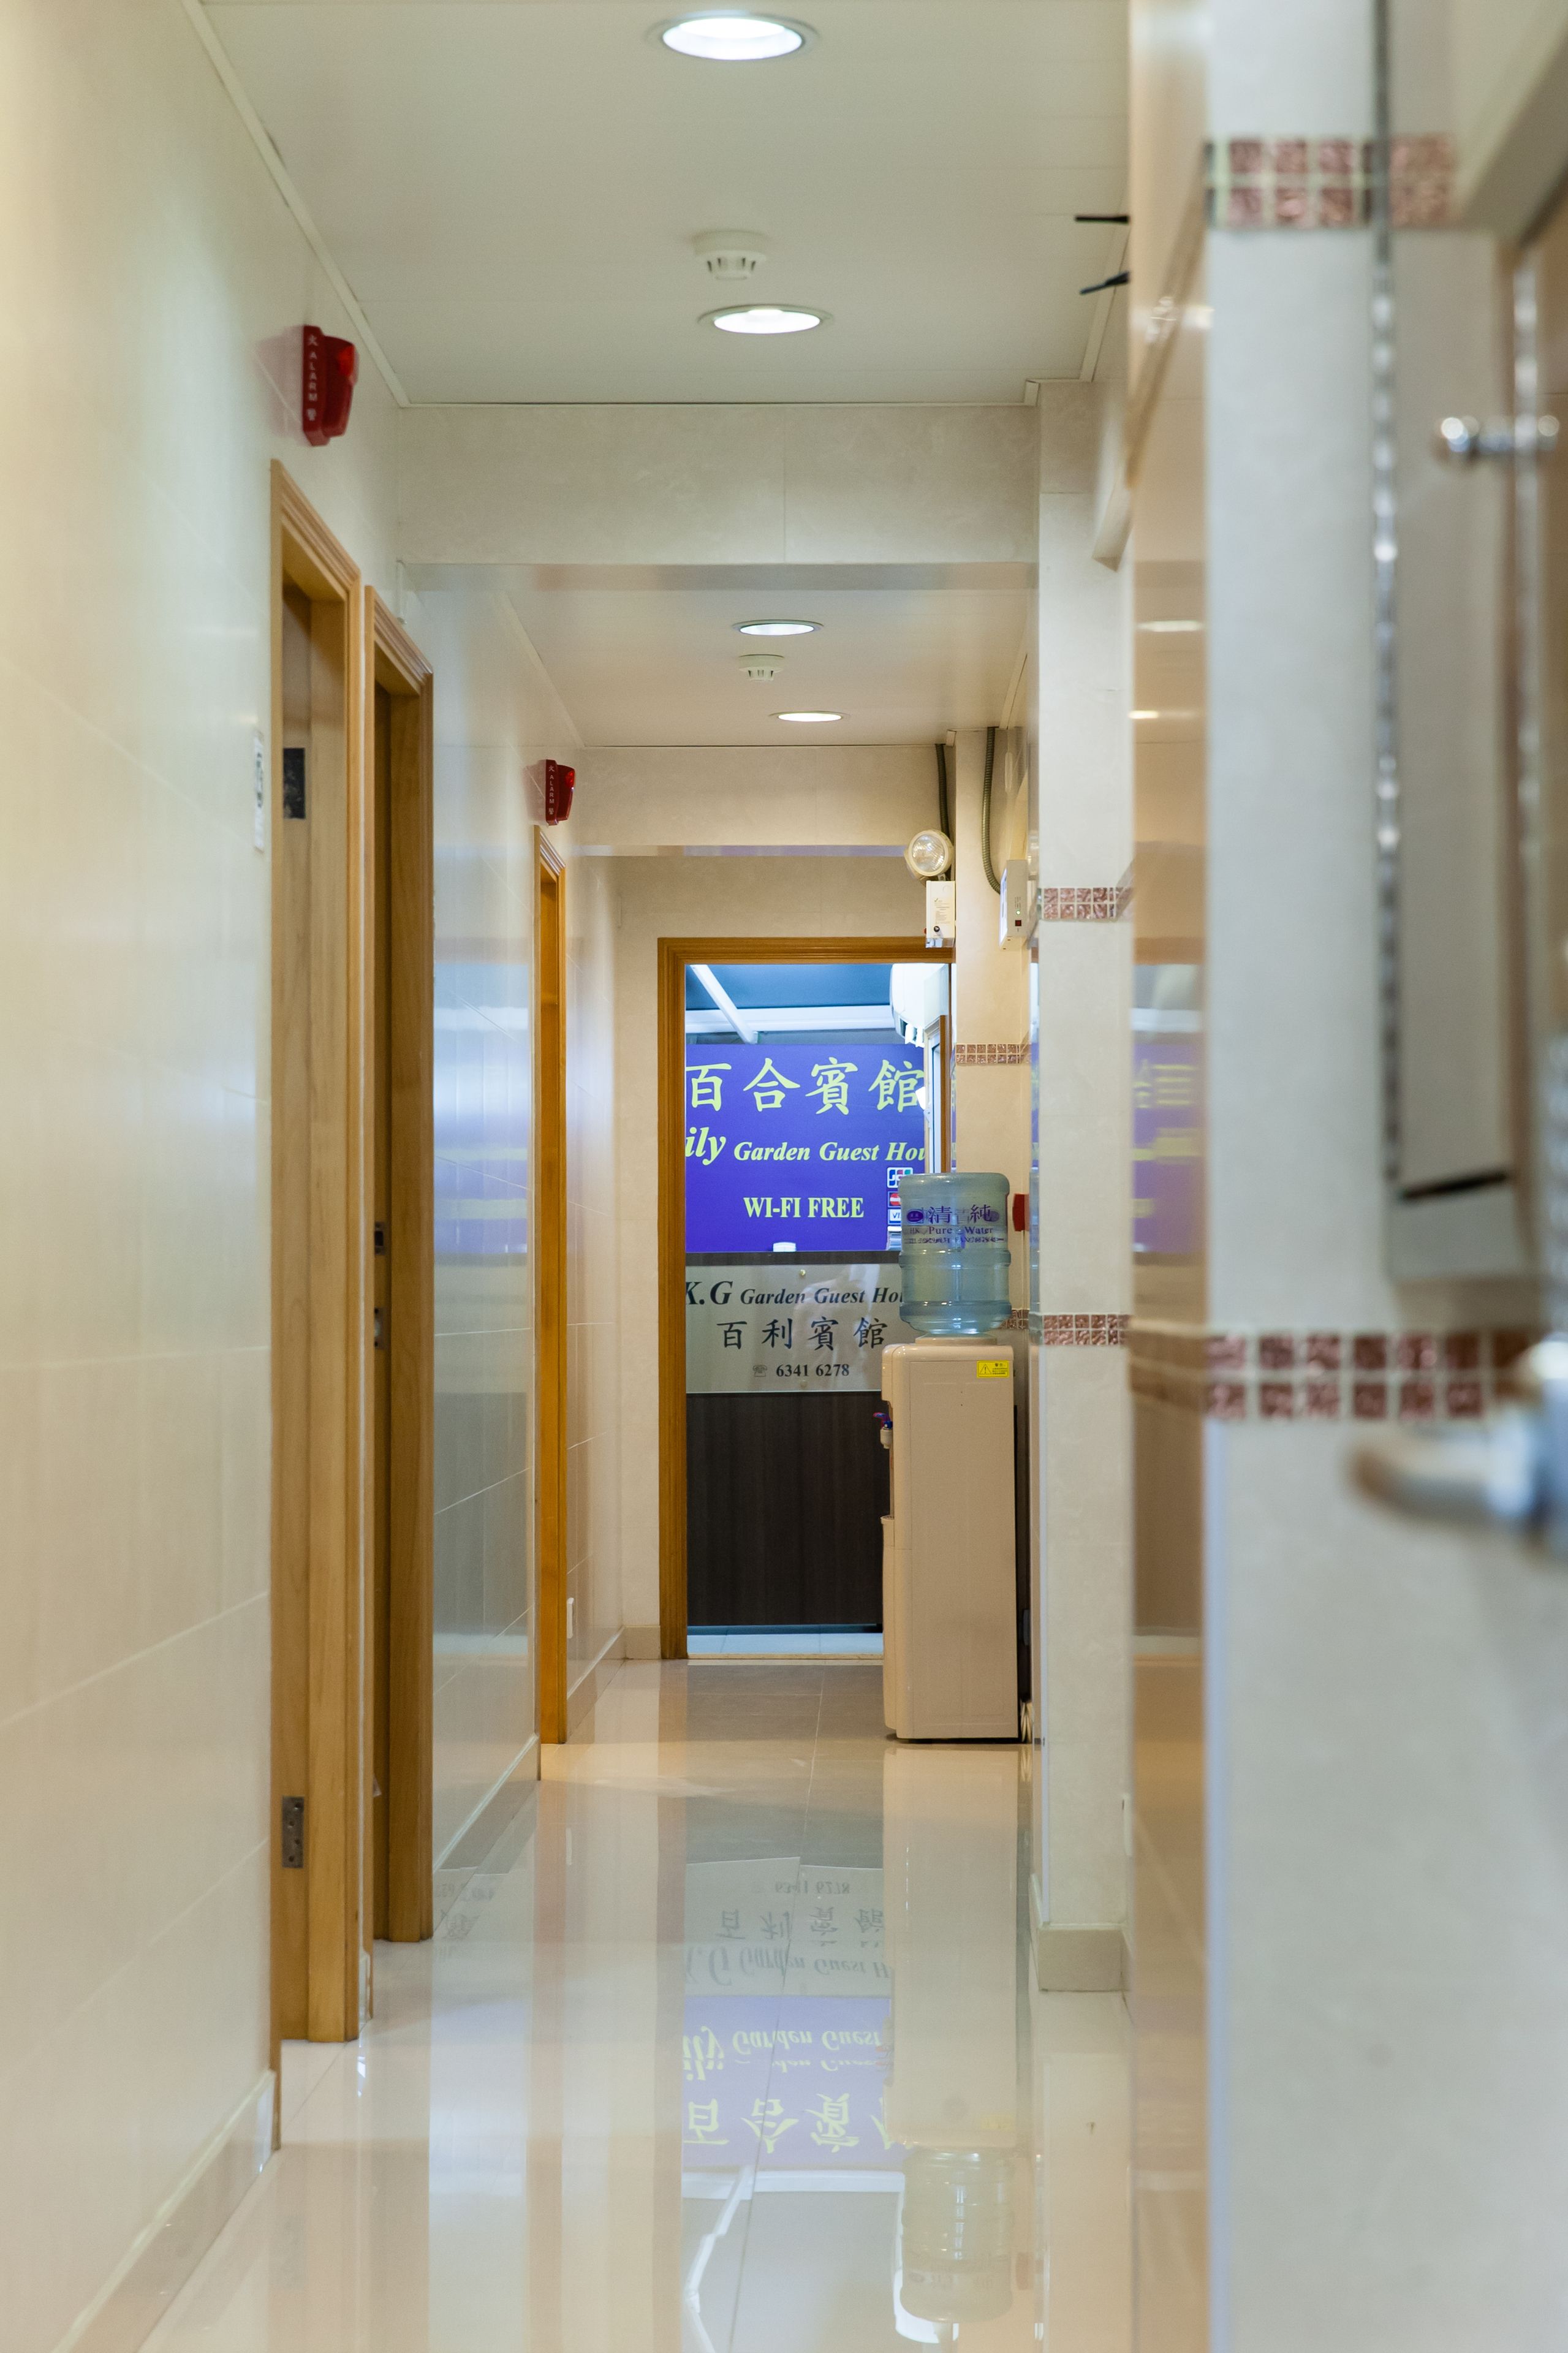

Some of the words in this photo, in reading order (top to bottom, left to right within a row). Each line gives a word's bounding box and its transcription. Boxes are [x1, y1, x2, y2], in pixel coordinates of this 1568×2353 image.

[308, 351, 317, 401] ALARM
[685, 1057, 926, 1115] 百合賓館
[685, 1127, 727, 1165] ily
[734, 1142, 810, 1161] Garden
[819, 1142, 880, 1161] Guest
[743, 1197, 801, 1218] WI-FI
[808, 1197, 864, 1218] FREE
[740, 1289, 805, 1305] Garden
[814, 1287, 865, 1303] Guest
[872, 1287, 903, 1303] Ho
[716, 1316, 888, 1351] 百利賓館
[776, 1364, 808, 1377] 6341
[816, 1363, 850, 1377] 6278
